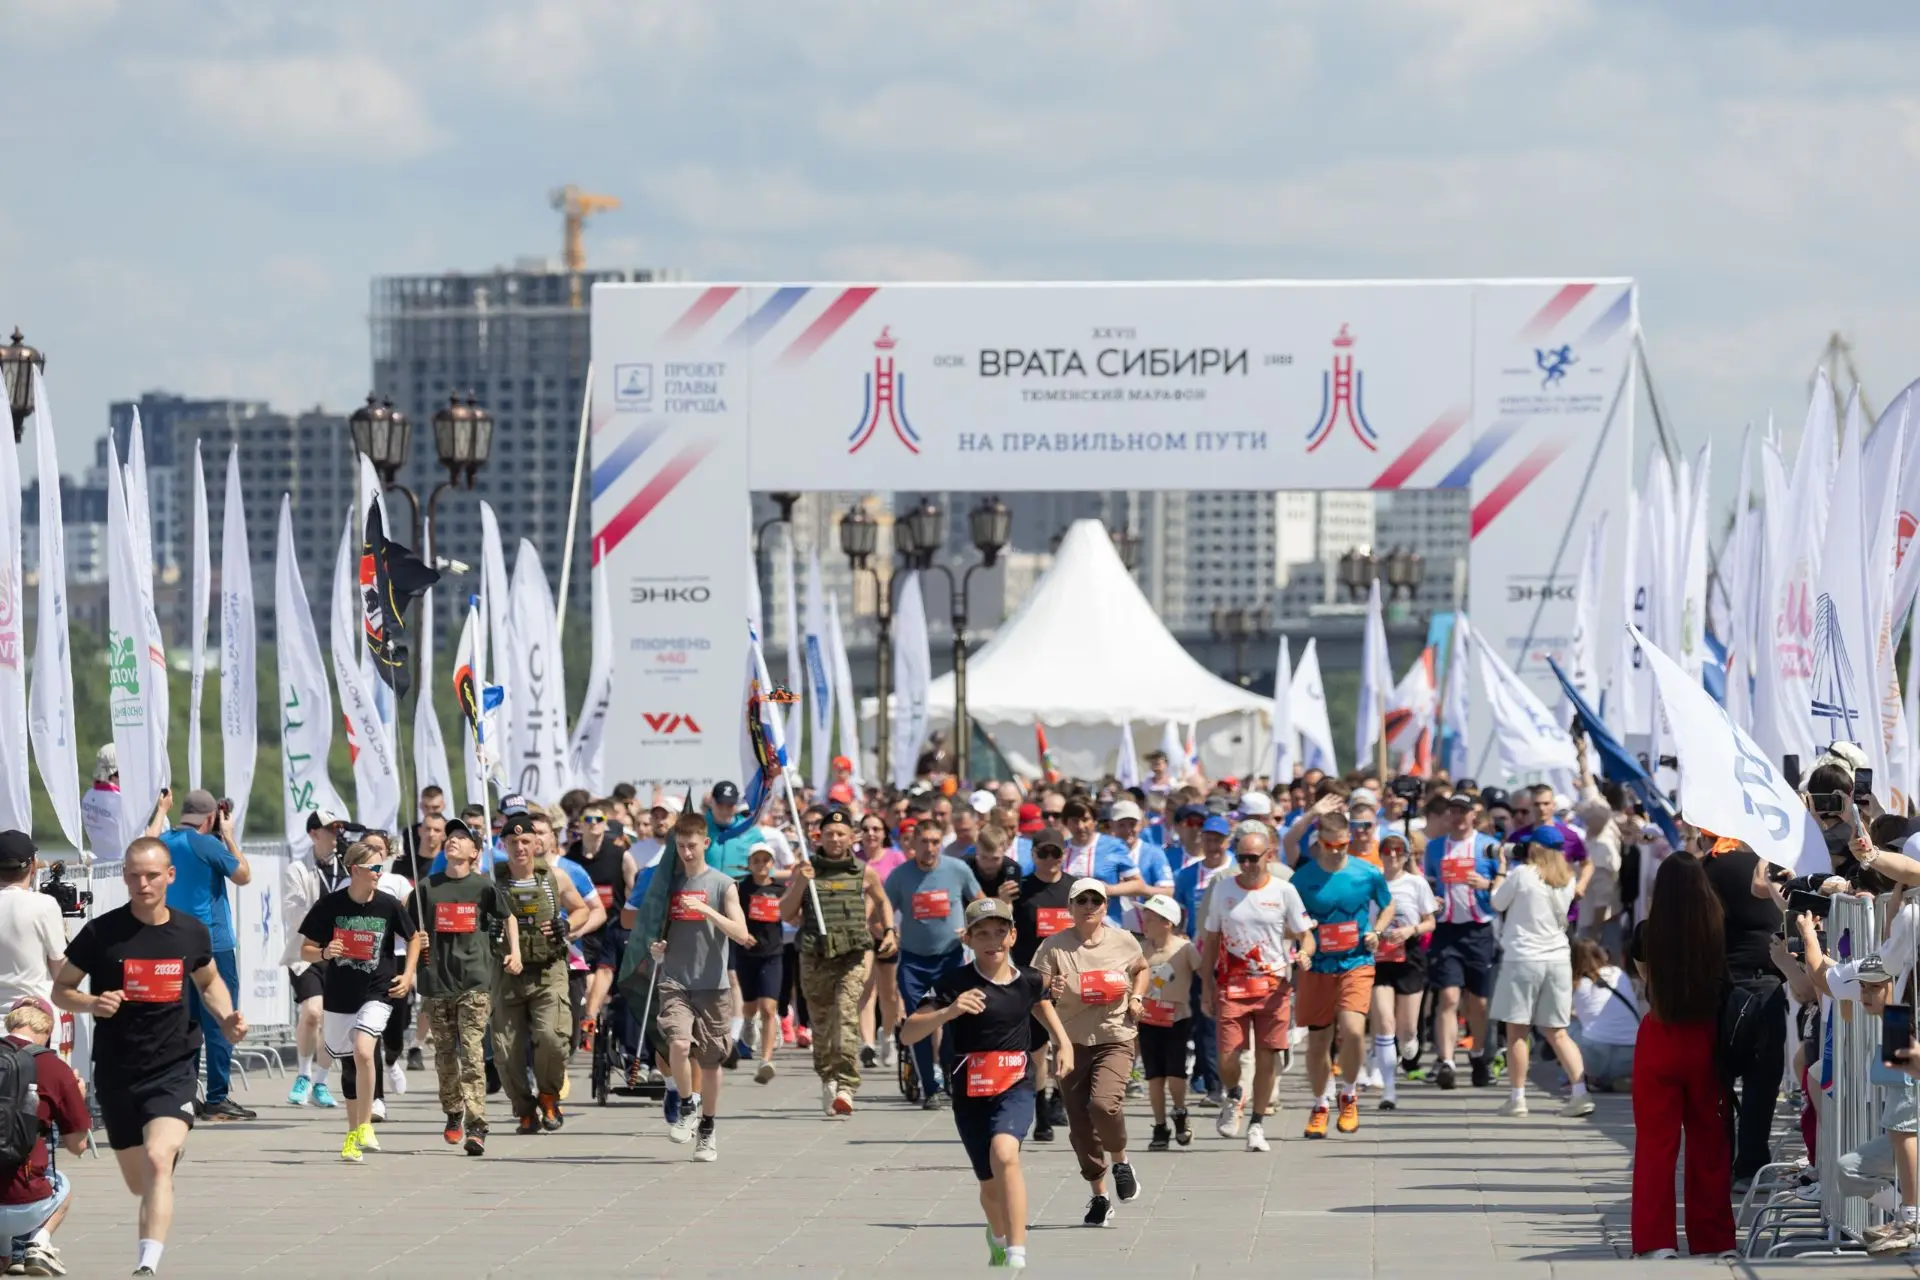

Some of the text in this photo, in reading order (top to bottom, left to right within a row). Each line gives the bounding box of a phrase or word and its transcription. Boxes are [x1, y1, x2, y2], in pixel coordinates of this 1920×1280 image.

[664, 362, 726, 378] ПРОЕКТ
[979, 348, 1249, 377] ВРАТА СИБИРИ
[664, 381, 717, 395] ГЛАВЫ
[1021, 387, 1207, 401] ТЮМЕНСКИЙ МАРАФОН
[664, 399, 728, 414] ГОРОДА
[958, 430, 1268, 452] НА ПРАВИЛЬНОМ ПУТИ
[630, 586, 711, 603] ЭНКО
[360, 713, 392, 777] ВОСТОК
